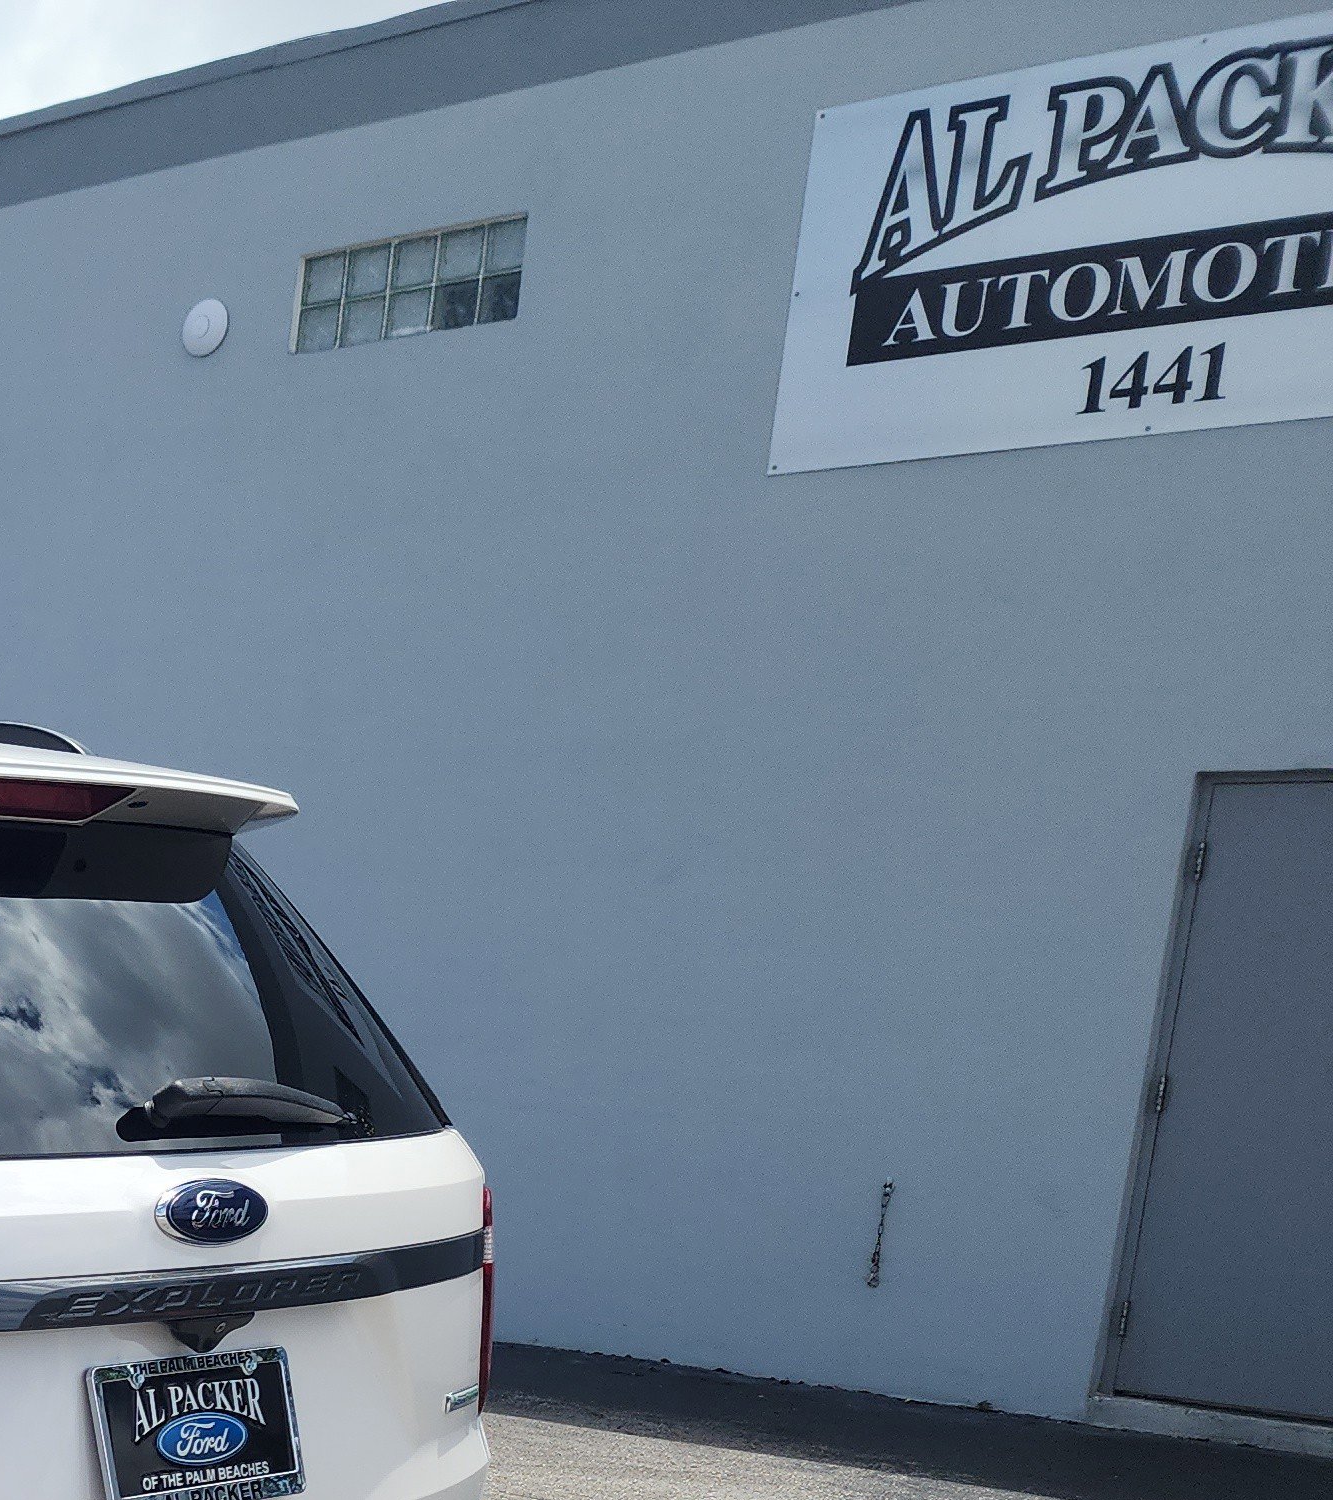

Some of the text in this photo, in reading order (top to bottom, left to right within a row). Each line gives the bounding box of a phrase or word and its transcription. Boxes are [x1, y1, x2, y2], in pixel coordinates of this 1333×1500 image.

[852, 95, 1033, 296] AL
[1075, 341, 1227, 416] 1441
[191, 1189, 251, 1230] Ford
[134, 1377, 267, 1443] AL PACKER
[176, 1422, 230, 1457] Ford
[142, 1460, 270, 1491] OF THE PALM BEACHES
